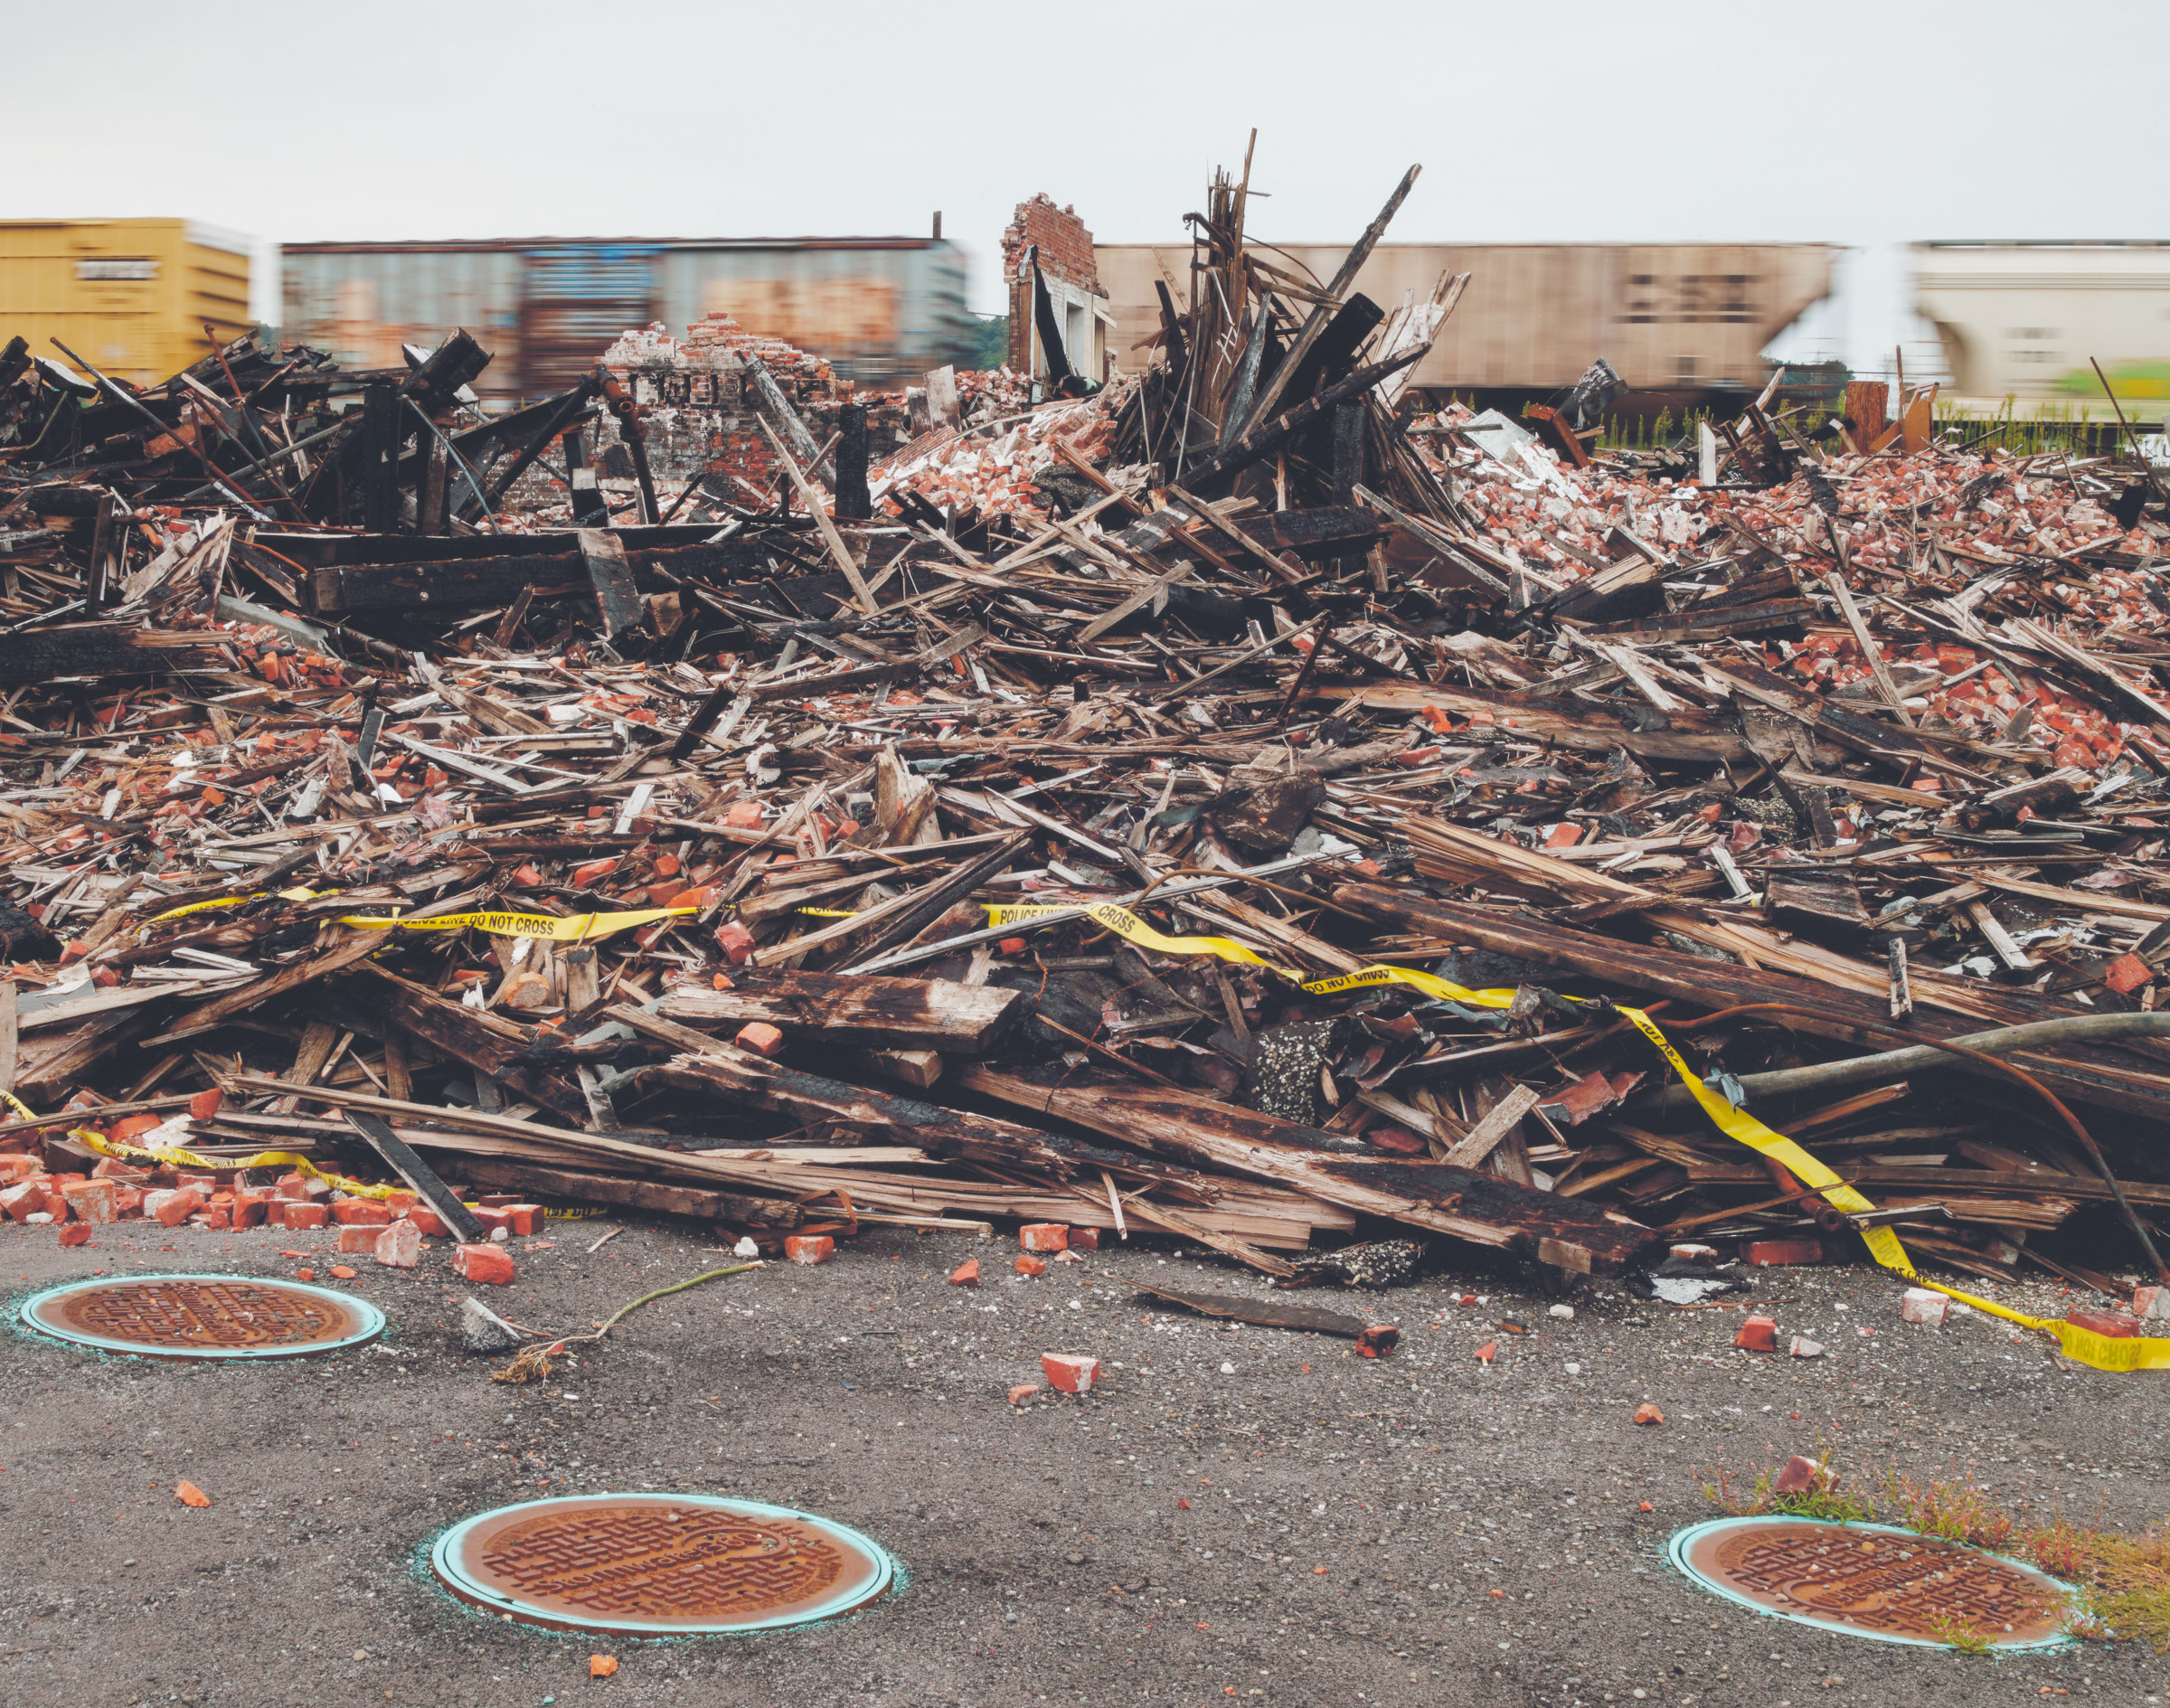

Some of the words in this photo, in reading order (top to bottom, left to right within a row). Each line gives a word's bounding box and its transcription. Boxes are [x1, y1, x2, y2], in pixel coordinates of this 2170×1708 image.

[469, 914, 486, 927] DO
[488, 915, 514, 930] NOT
[515, 917, 554, 936] CROSS
[1098, 905, 1136, 933] CROSS
[1305, 983, 1325, 993] DO
[534, 1532, 763, 1594] Stormwater360
